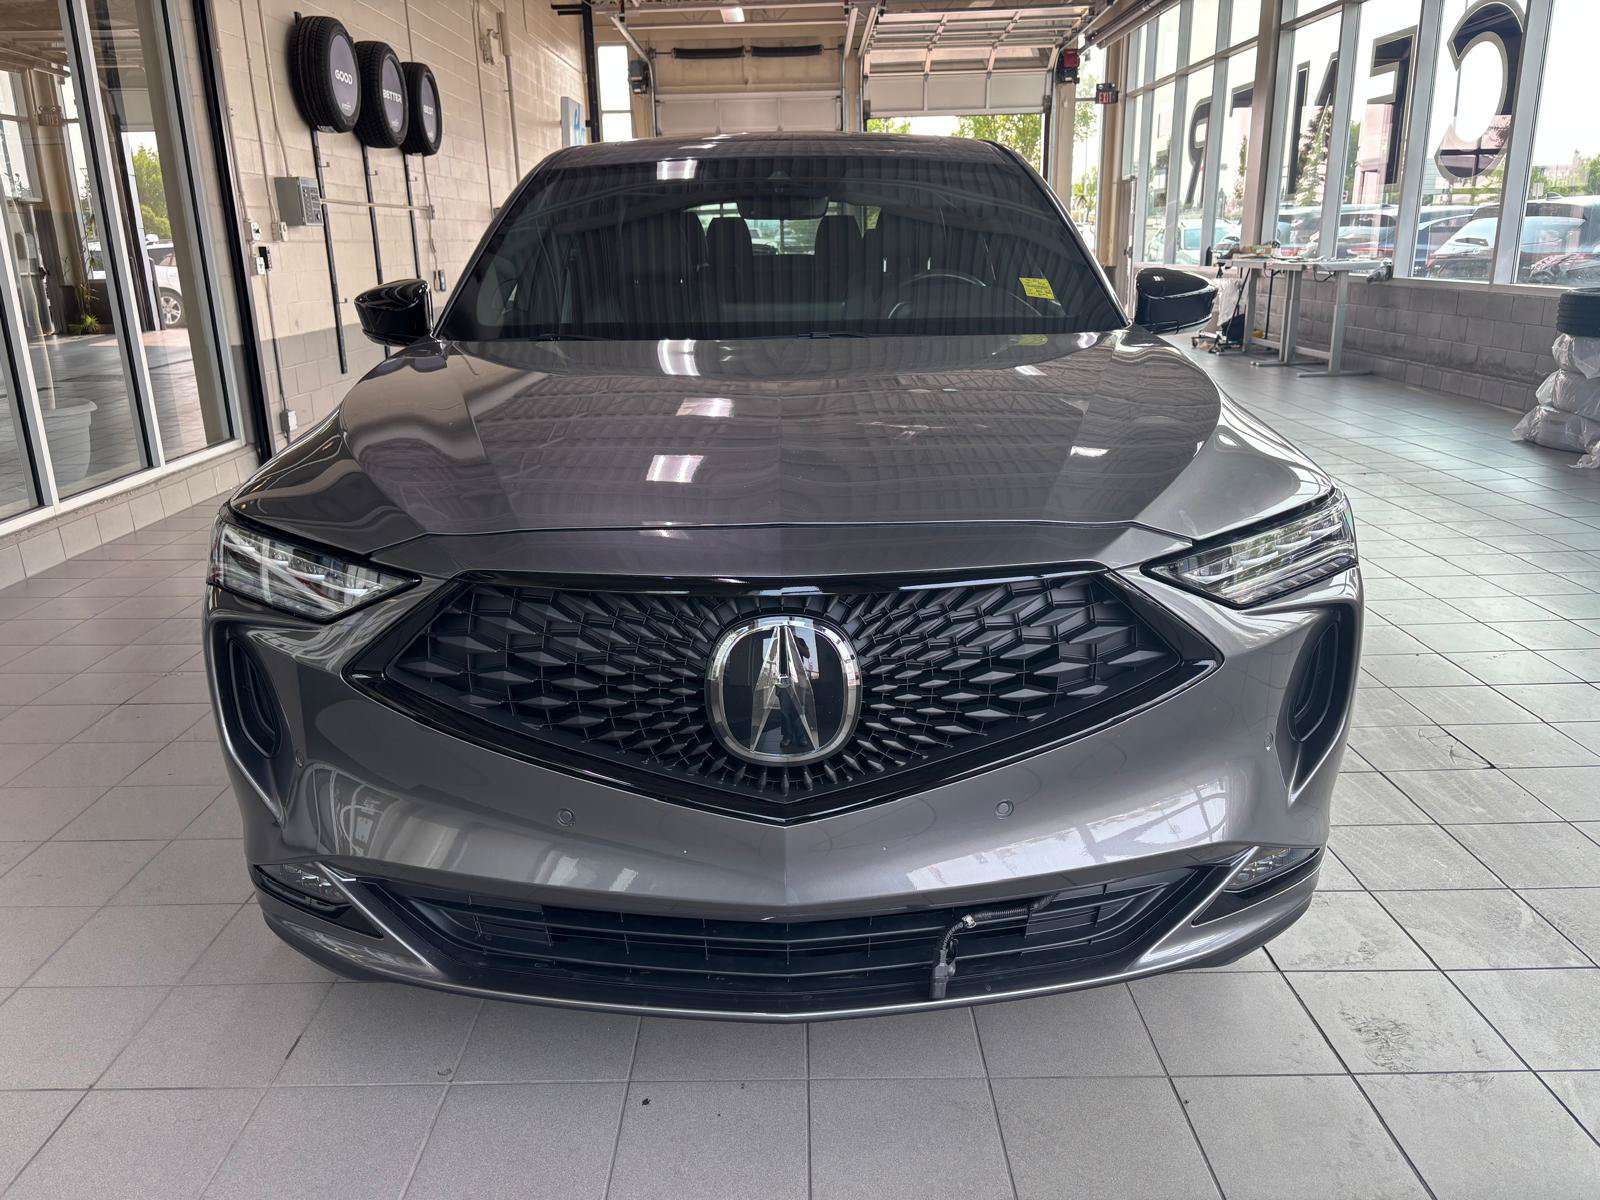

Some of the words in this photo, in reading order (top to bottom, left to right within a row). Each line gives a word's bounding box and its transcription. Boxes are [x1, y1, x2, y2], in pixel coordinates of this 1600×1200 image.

[335, 69, 352, 84] GOOD
[382, 89, 402, 104] BETTER
[423, 105, 433, 115] BEST
